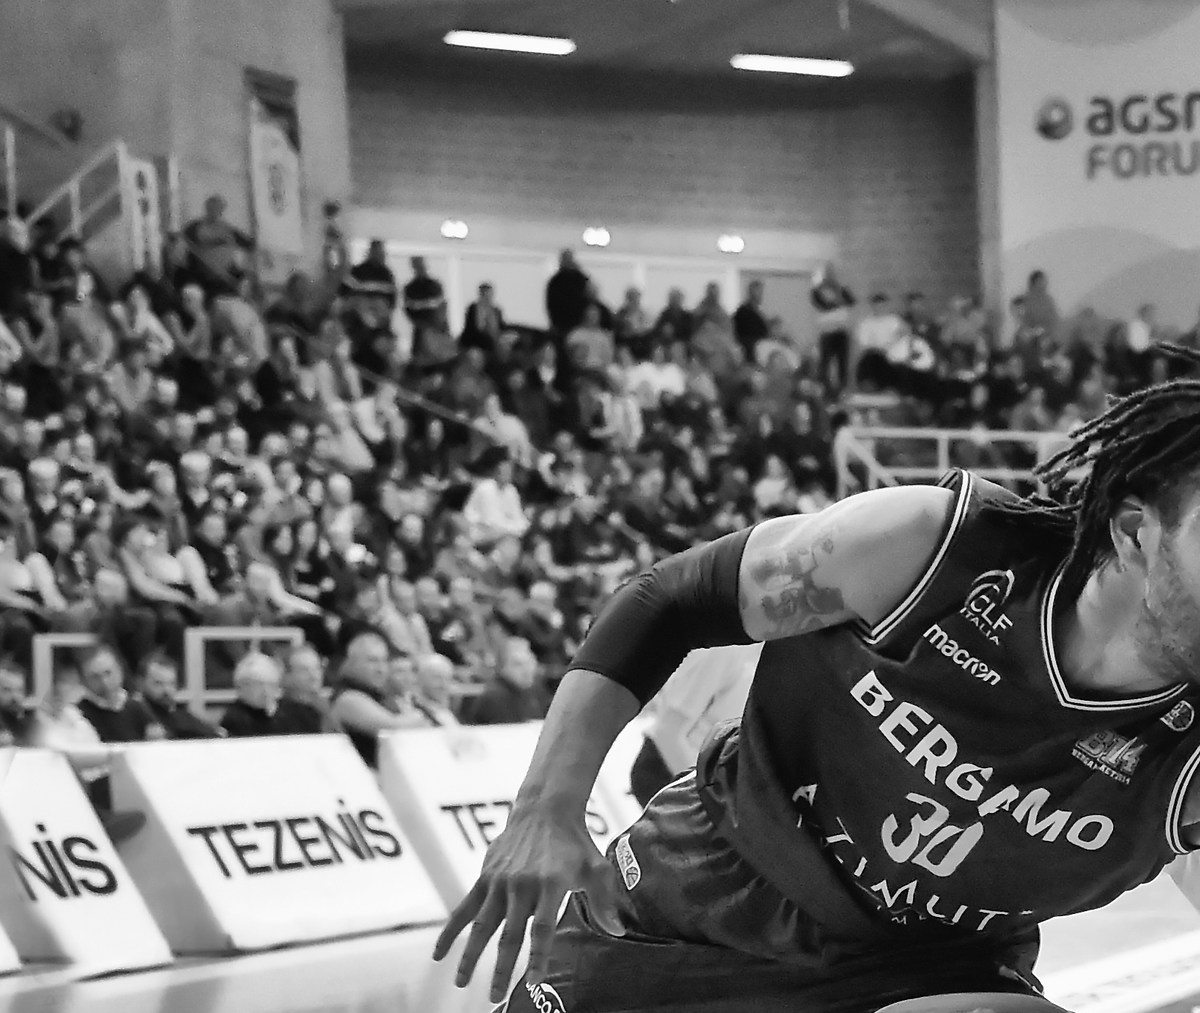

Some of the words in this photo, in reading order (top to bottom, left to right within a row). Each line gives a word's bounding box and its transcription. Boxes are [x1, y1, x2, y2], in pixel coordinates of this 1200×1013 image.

[959, 606, 1001, 646] ITALIA
[970, 594, 1014, 630] CLF
[922, 623, 1002, 686] macron
[187, 798, 402, 879] TEZENIS
[881, 792, 984, 877] 30
